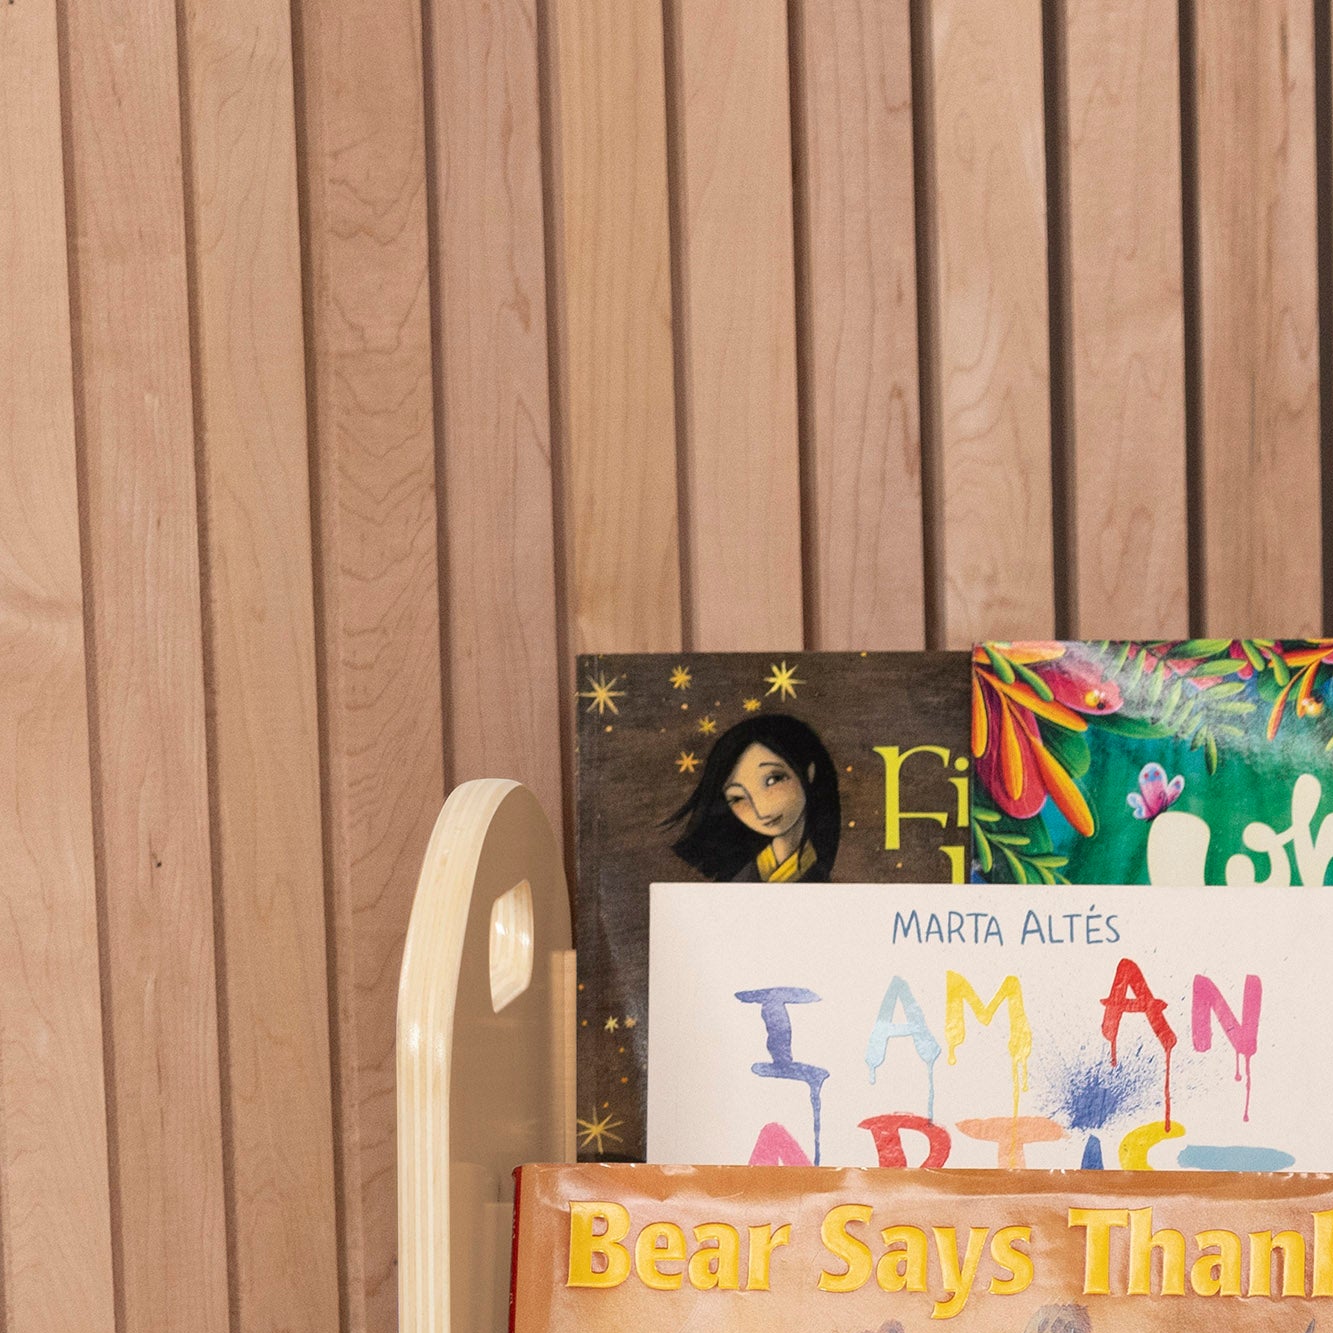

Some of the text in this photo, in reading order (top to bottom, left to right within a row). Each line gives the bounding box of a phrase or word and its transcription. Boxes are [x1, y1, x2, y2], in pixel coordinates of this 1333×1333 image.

[872, 744, 970, 850] Fi
[891, 905, 1122, 946] MARTA ALTÉS
[734, 957, 1262, 1095] I AM AN
[565, 1200, 792, 1293] Bear
[818, 1203, 1035, 1319] Says
